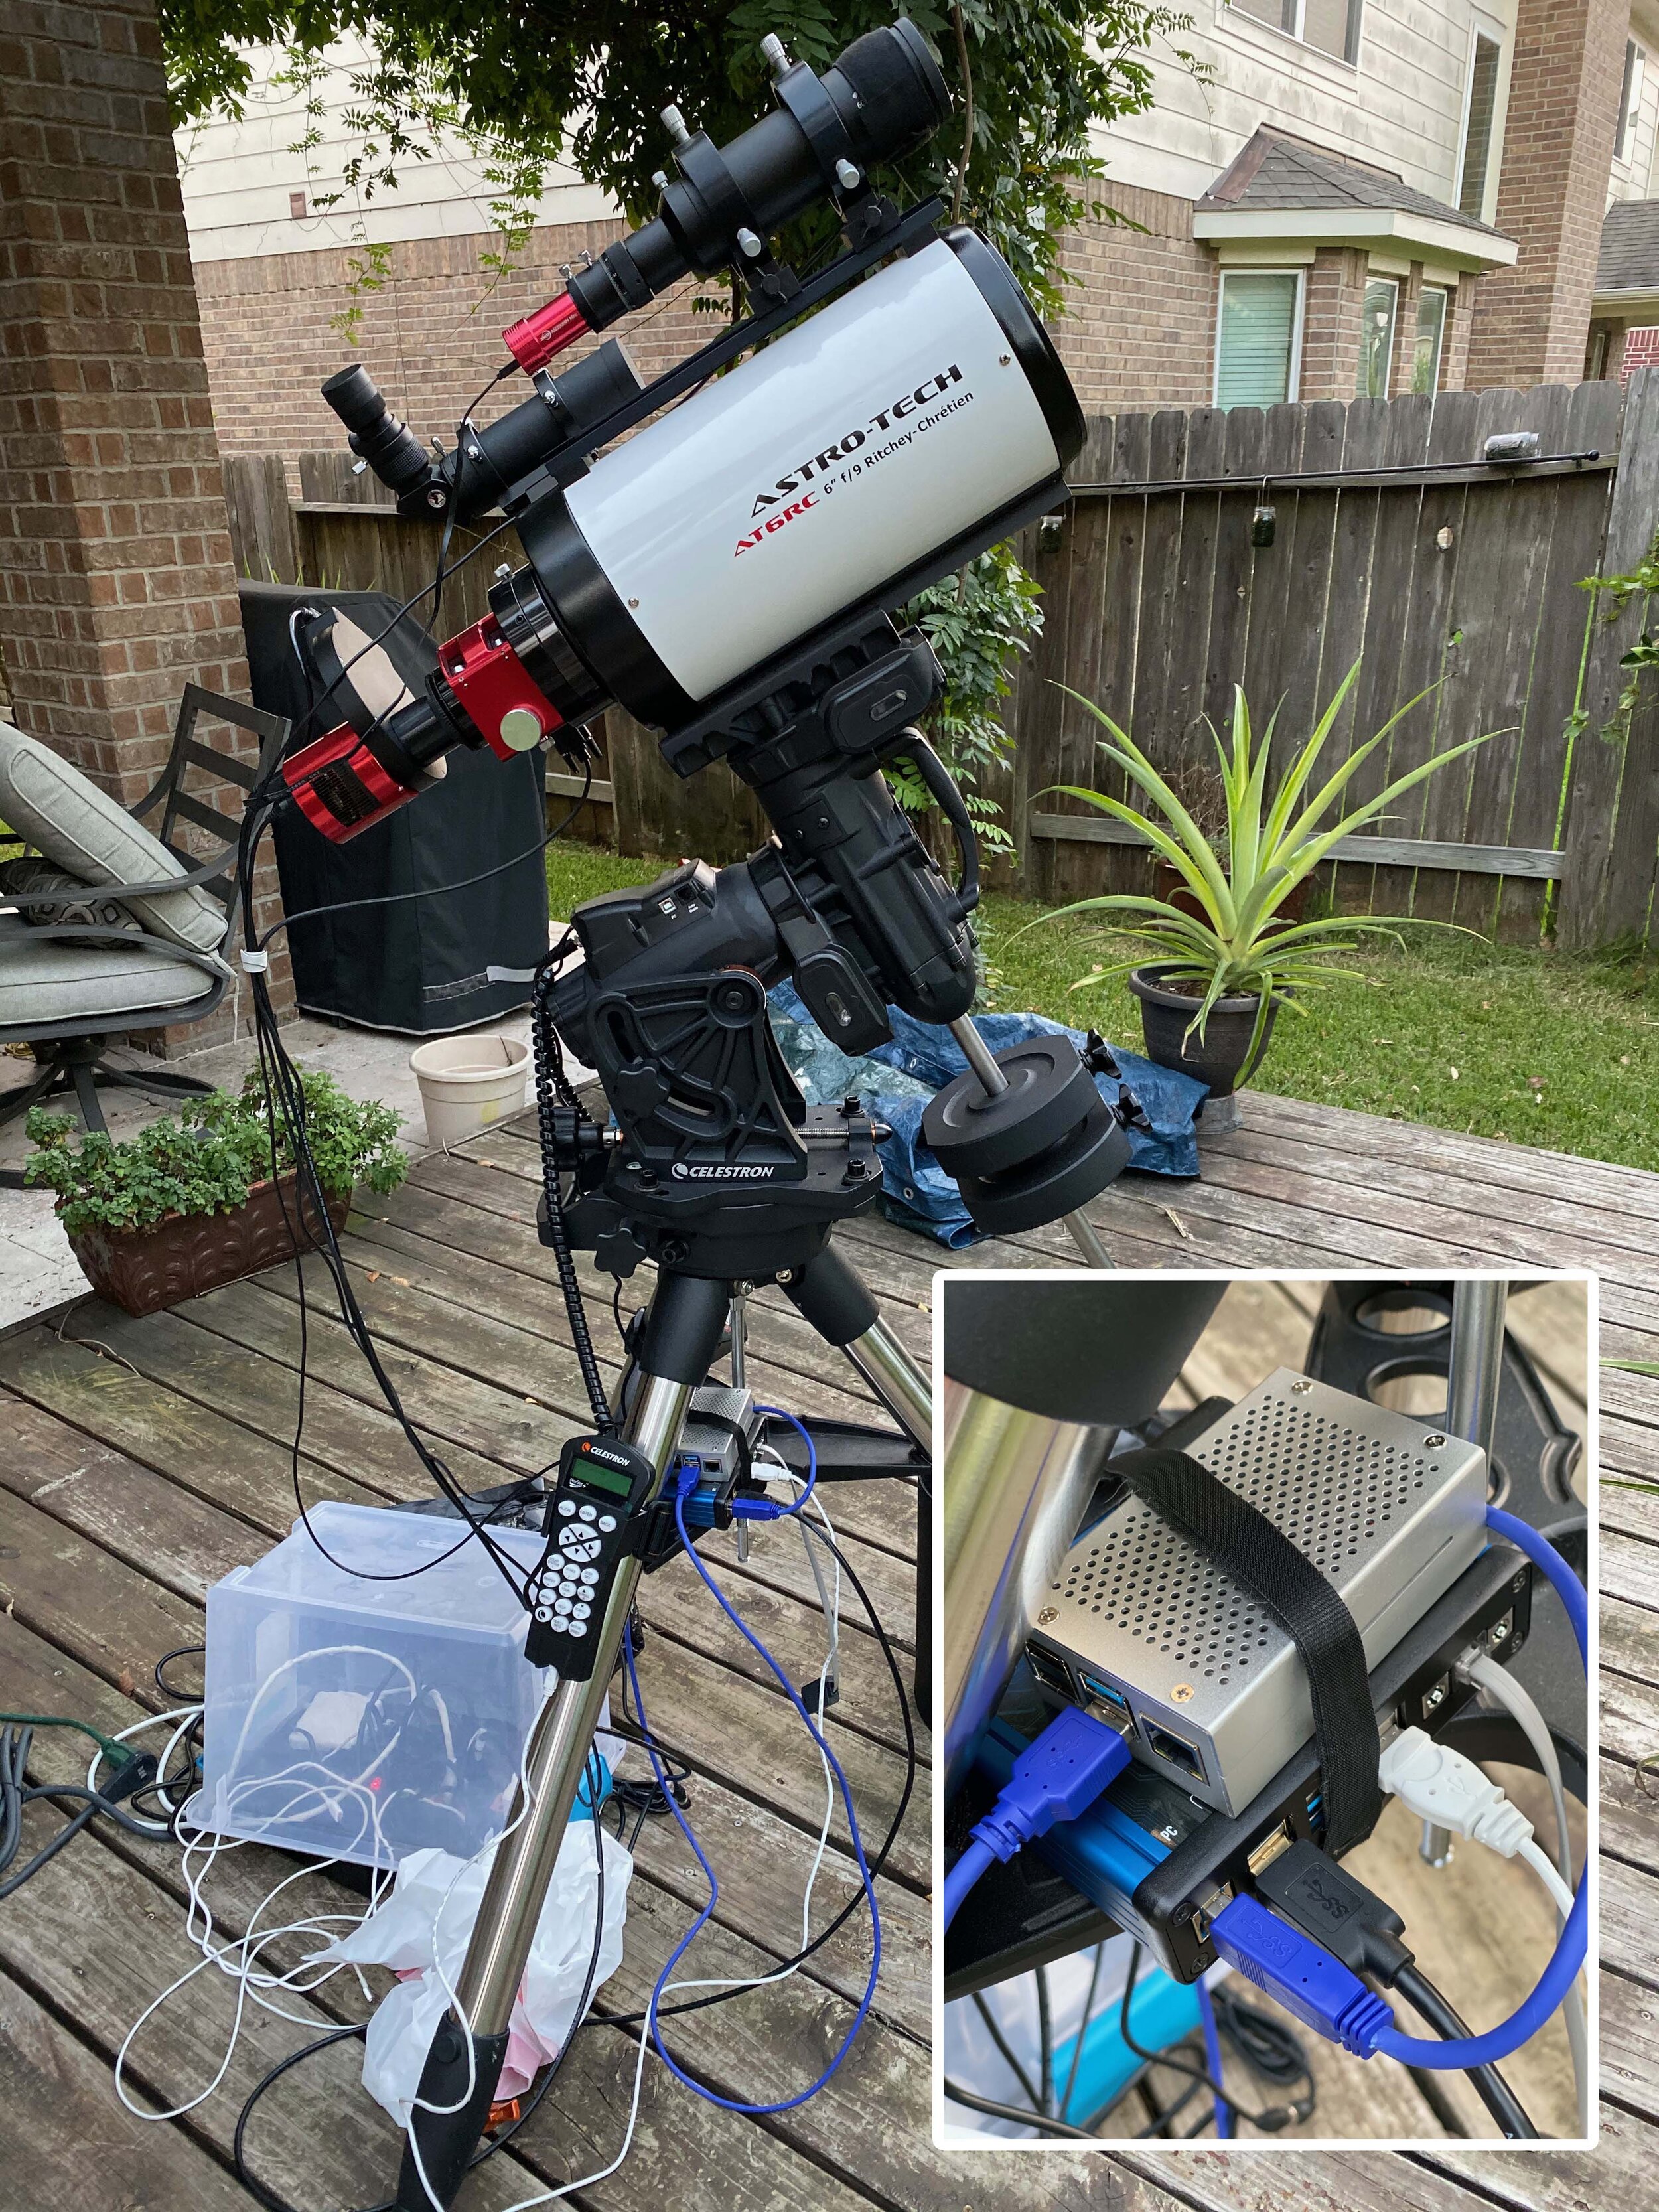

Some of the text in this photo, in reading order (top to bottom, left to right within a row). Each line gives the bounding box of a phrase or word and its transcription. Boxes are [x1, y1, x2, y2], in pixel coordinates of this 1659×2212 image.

[751, 364, 964, 518] ASTRO-TECH
[734, 491, 820, 557] AT6RC
[841, 465, 862, 484] f/9
[864, 392, 974, 468] Ritchey-Chrétien
[689, 1166, 774, 1177] CELESTRON
[590, 1447, 630, 1467] CELESTRON
[1160, 1826, 1178, 1842] PC
